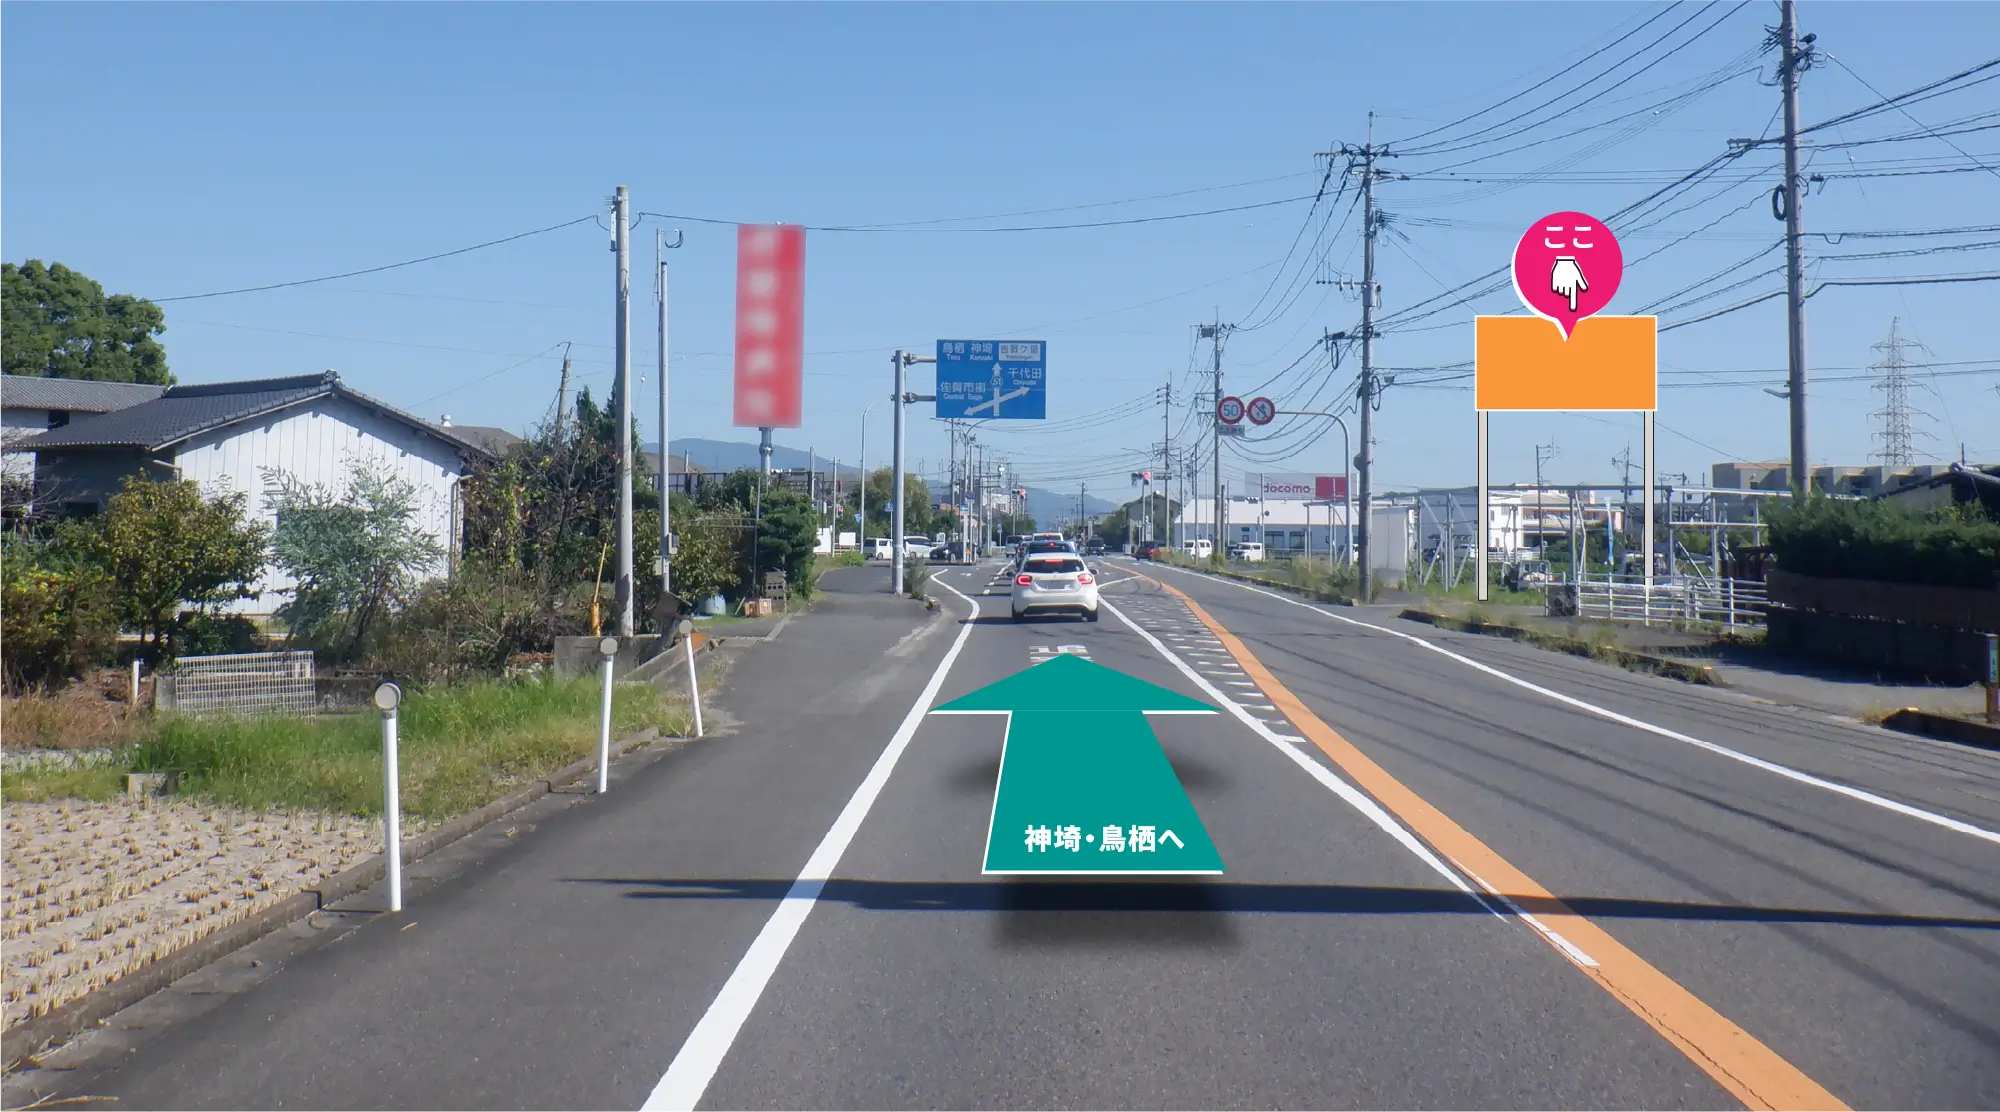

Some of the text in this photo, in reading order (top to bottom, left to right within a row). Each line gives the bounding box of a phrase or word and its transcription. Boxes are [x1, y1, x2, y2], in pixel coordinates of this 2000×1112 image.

[1008, 367, 1042, 379] 千代田
[1222, 404, 1239, 416] 50
[1263, 482, 1311, 493] docomo
